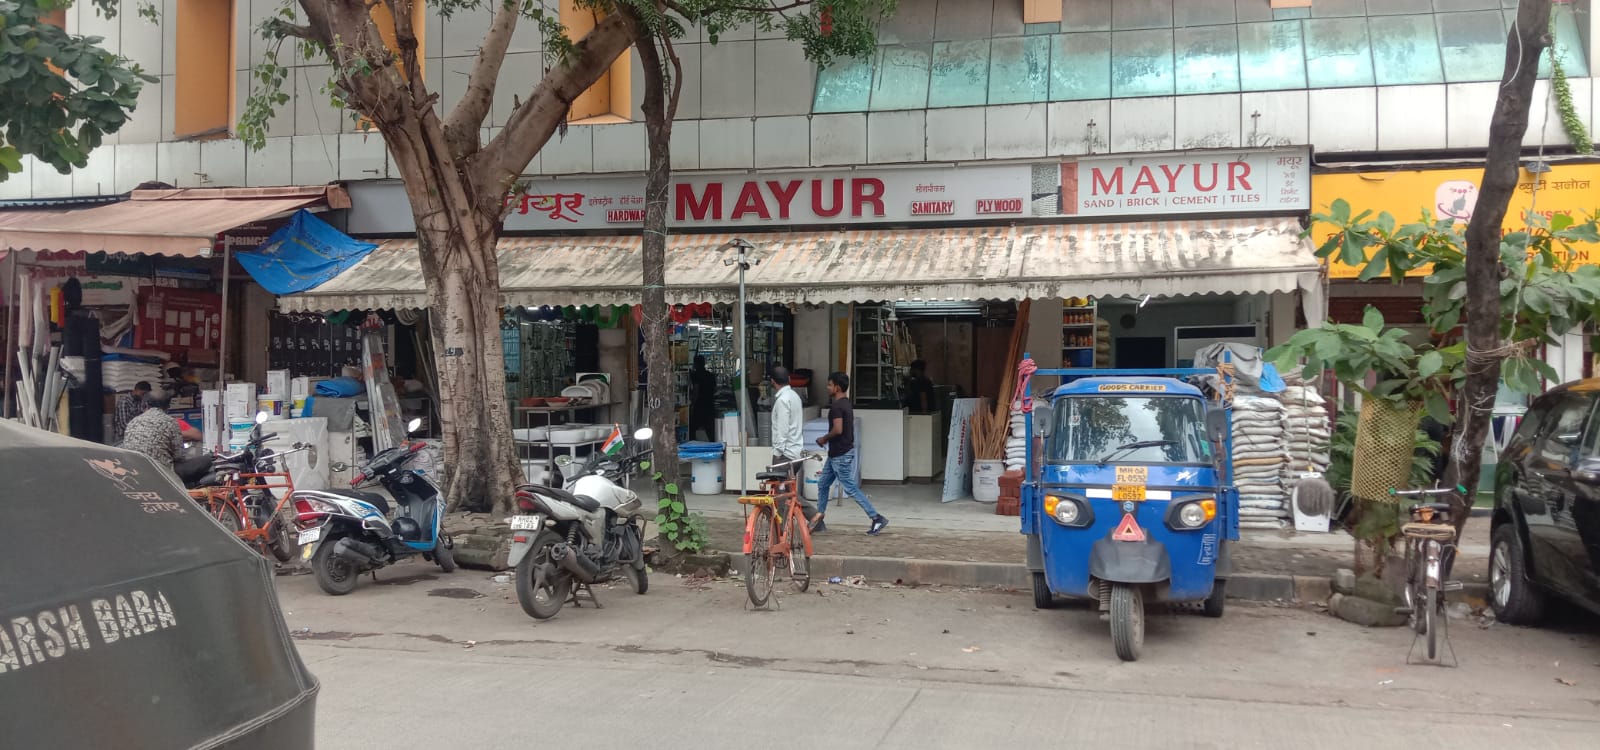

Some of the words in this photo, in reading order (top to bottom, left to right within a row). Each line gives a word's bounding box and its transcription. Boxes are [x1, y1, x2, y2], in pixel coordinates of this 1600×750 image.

[1276, 156, 1304, 169] मयूर
[1091, 161, 1253, 196] MAYUR
[1552, 178, 1591, 191] सलोन
[675, 177, 886, 222] MAYUR
[976, 199, 1022, 212] PLYWOOD
[1083, 199, 1115, 209] SAND
[1127, 197, 1160, 207] BRICK
[1172, 195, 1218, 205] CEMENT
[1231, 193, 1260, 203] TILES
[912, 201, 953, 213] SANITARY
[607, 210, 646, 222] HARDWAR
[1520, 210, 1572, 222] USX
[91, 589, 177, 644] BABA
